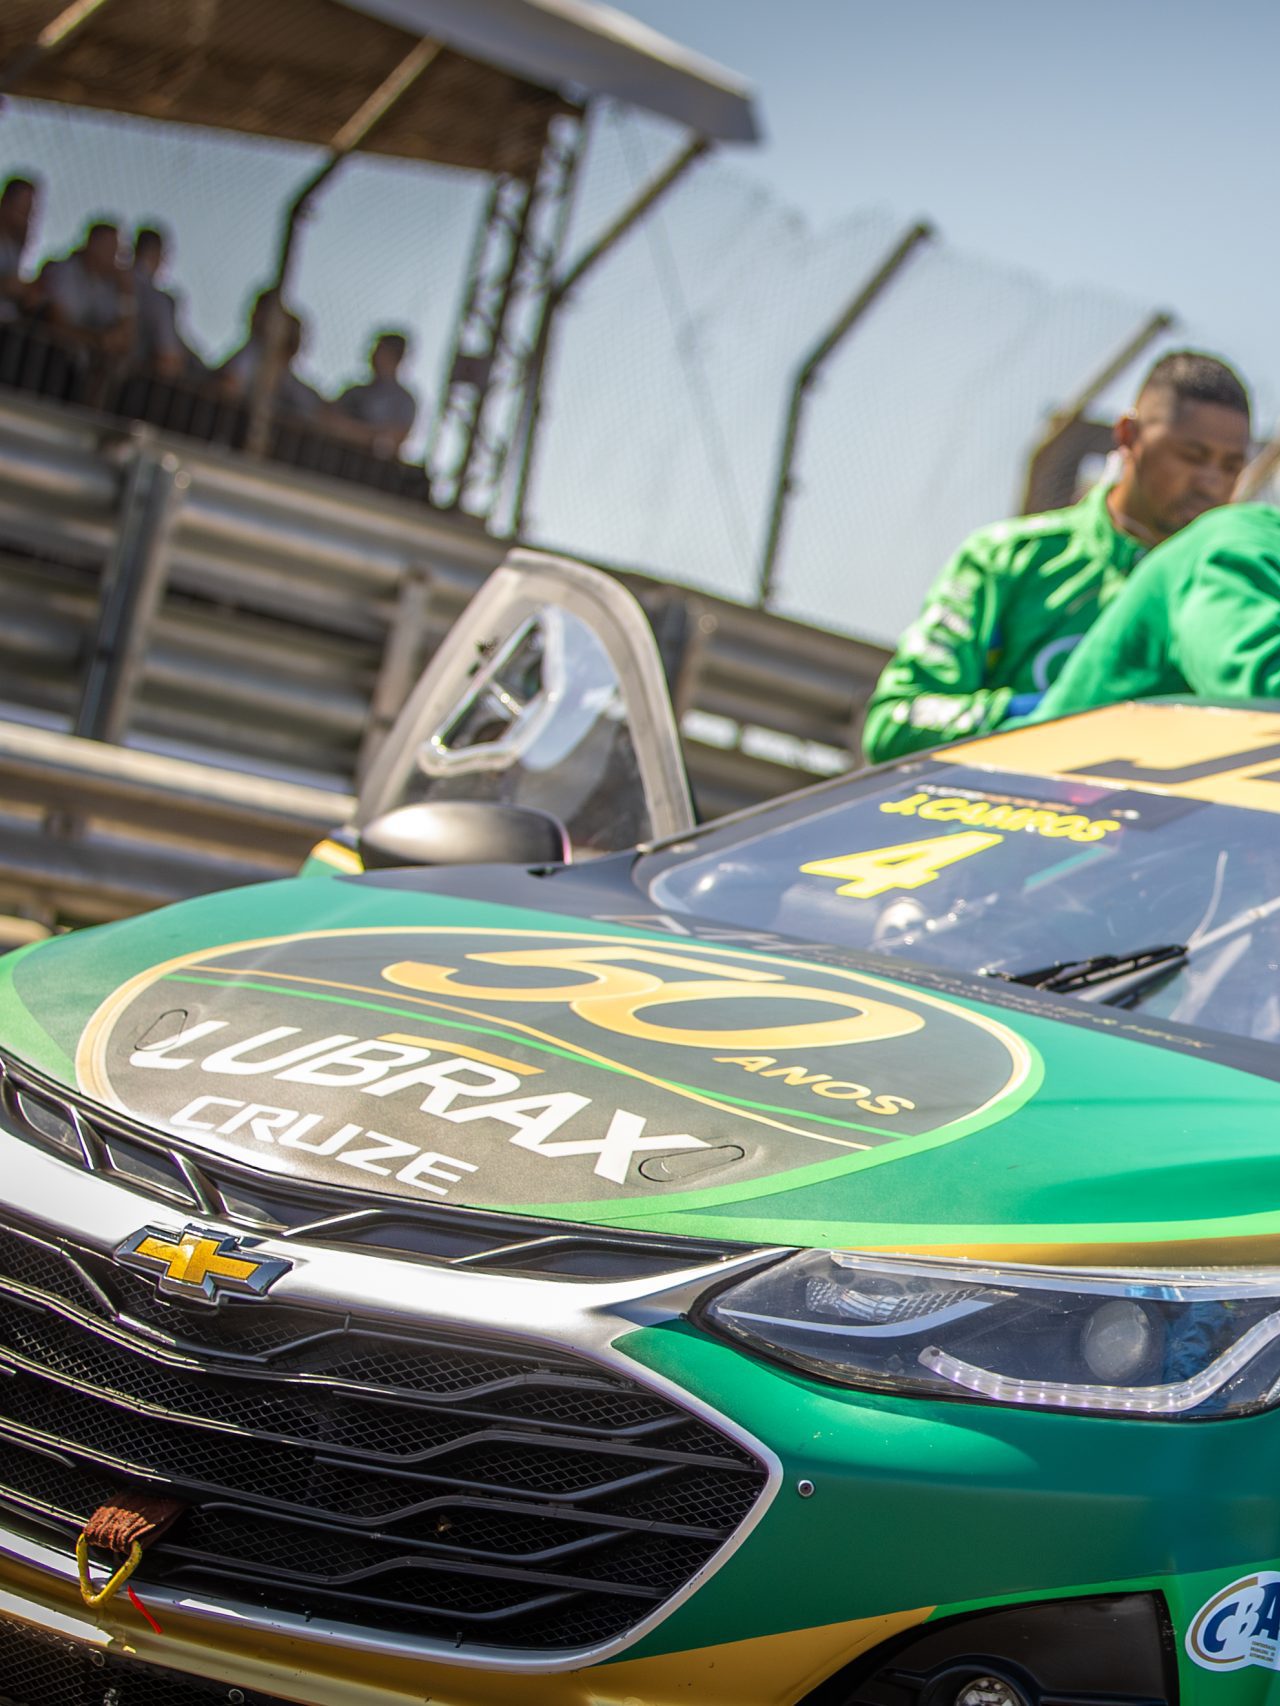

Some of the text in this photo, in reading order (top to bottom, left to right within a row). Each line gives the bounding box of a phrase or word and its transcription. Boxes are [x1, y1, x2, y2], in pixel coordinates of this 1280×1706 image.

[800, 830, 1004, 899] 4
[382, 945, 925, 1050] 50
[129, 1020, 714, 1186] LUBRAX
[711, 1054, 916, 1117] ANOS
[168, 1095, 479, 1196] CRUZE
